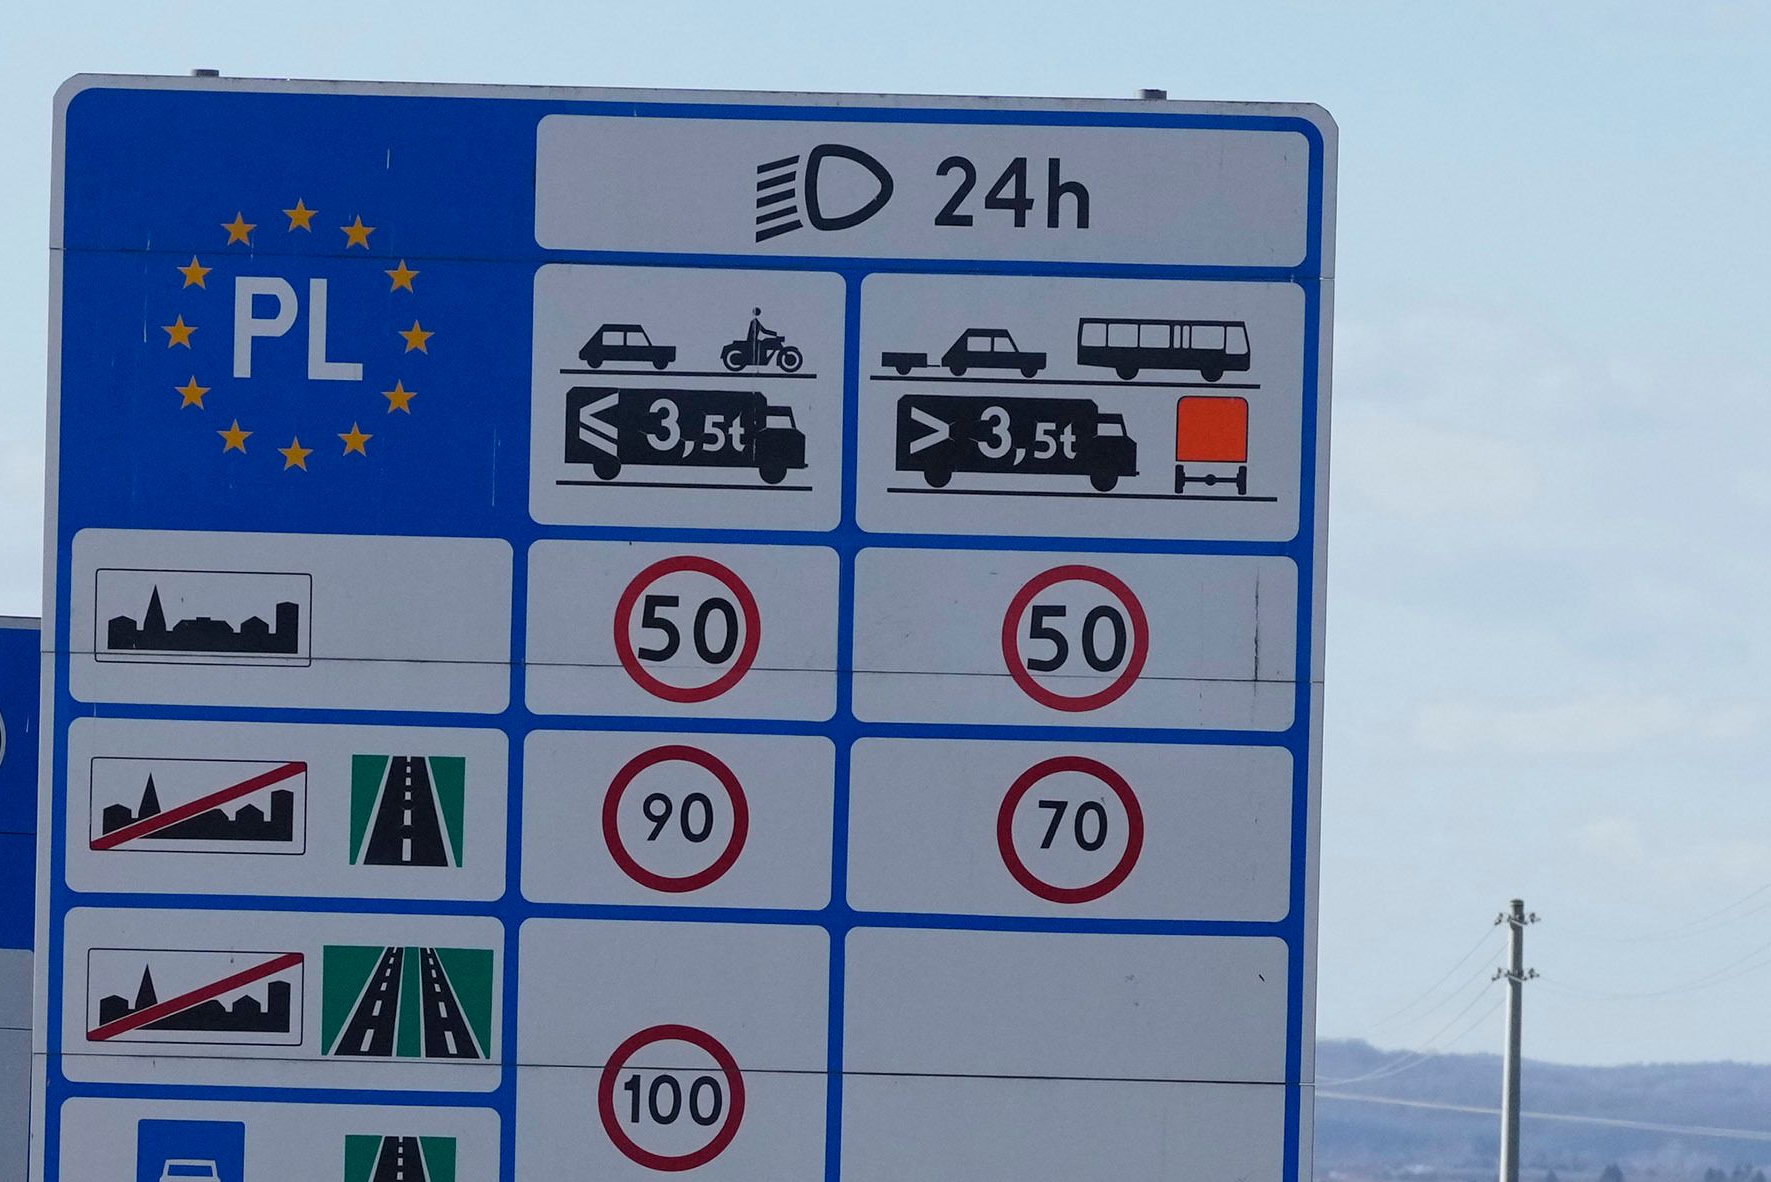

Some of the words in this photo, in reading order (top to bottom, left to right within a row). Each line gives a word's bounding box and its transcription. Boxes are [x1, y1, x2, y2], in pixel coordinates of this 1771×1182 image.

[934, 155, 1091, 230] 24h
[232, 275, 363, 382] PL
[645, 397, 747, 459] 3,5t
[977, 405, 1077, 466] 3,5t
[637, 594, 739, 665] 50
[1027, 604, 1127, 673] 50
[642, 791, 715, 844] 90
[1037, 799, 1109, 852] 70
[622, 1073, 724, 1127] 100
